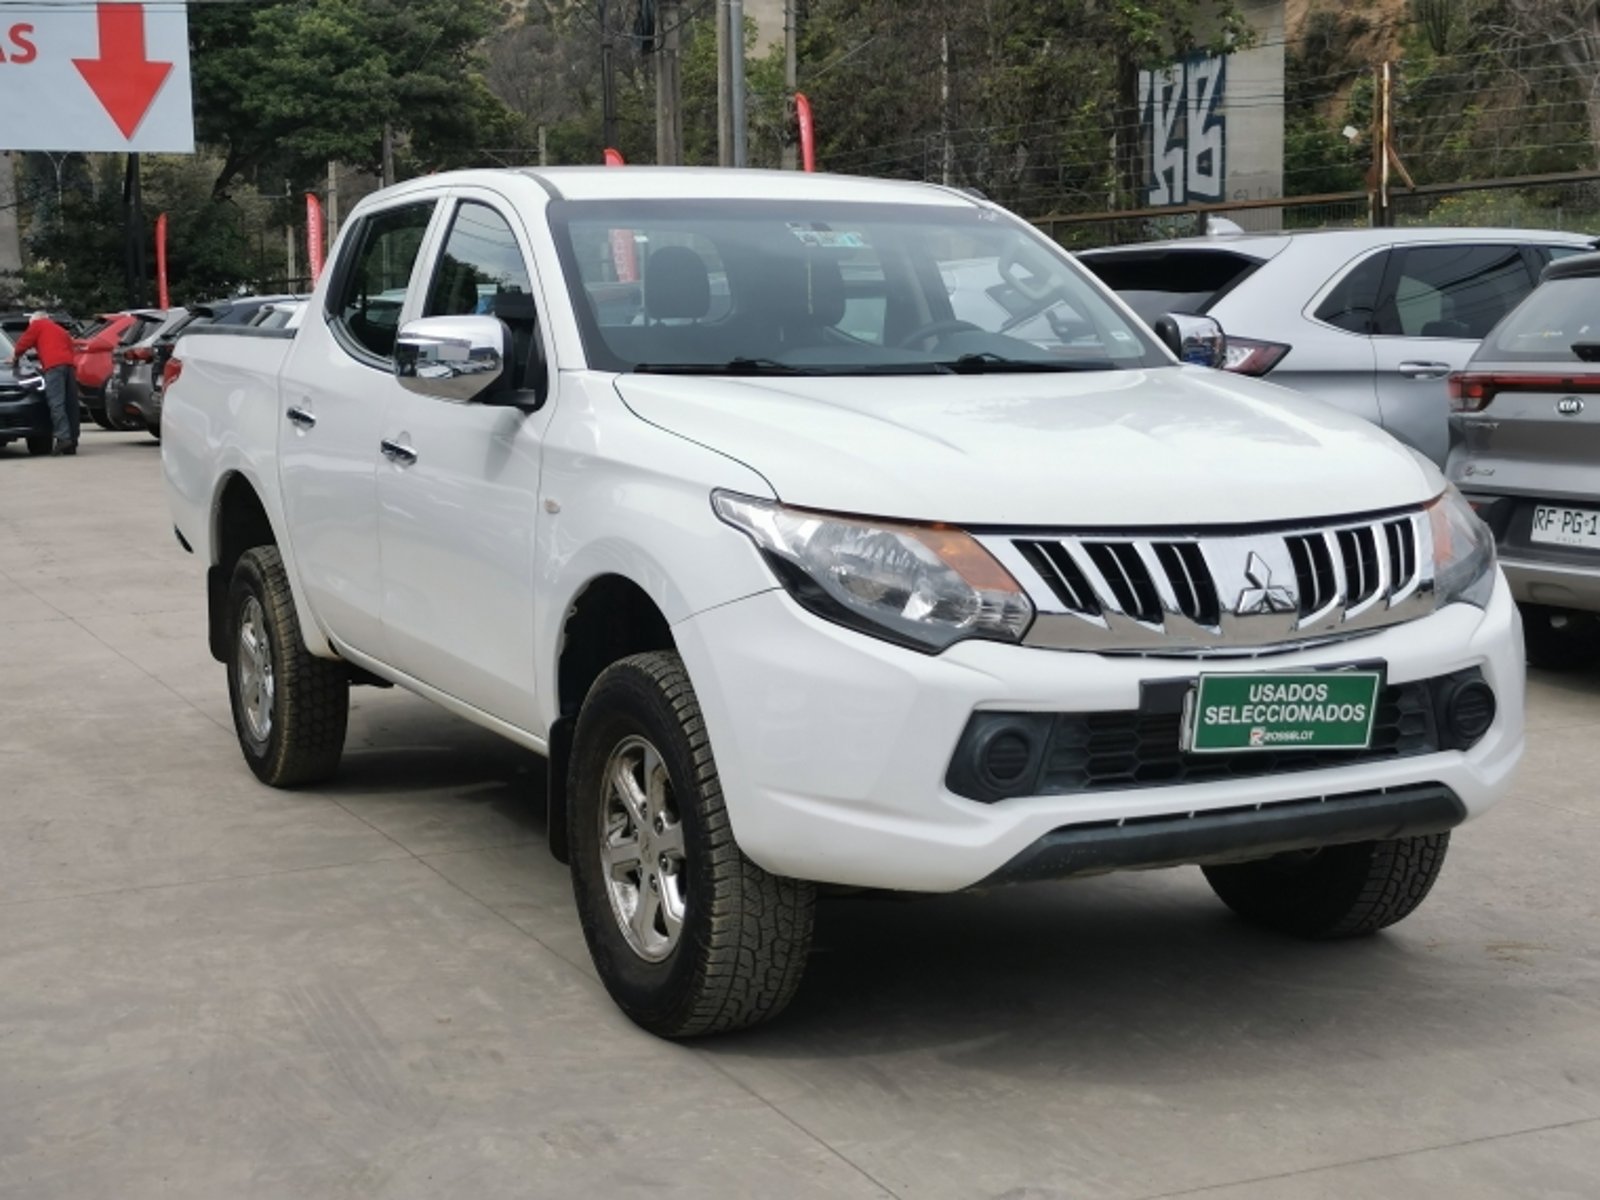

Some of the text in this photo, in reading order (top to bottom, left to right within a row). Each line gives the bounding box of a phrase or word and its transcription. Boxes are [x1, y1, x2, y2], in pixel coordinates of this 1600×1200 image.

[0, 23, 37, 64] S
[1249, 684, 1328, 702] USADOS
[1204, 704, 1366, 725] SELECCIONADOS
